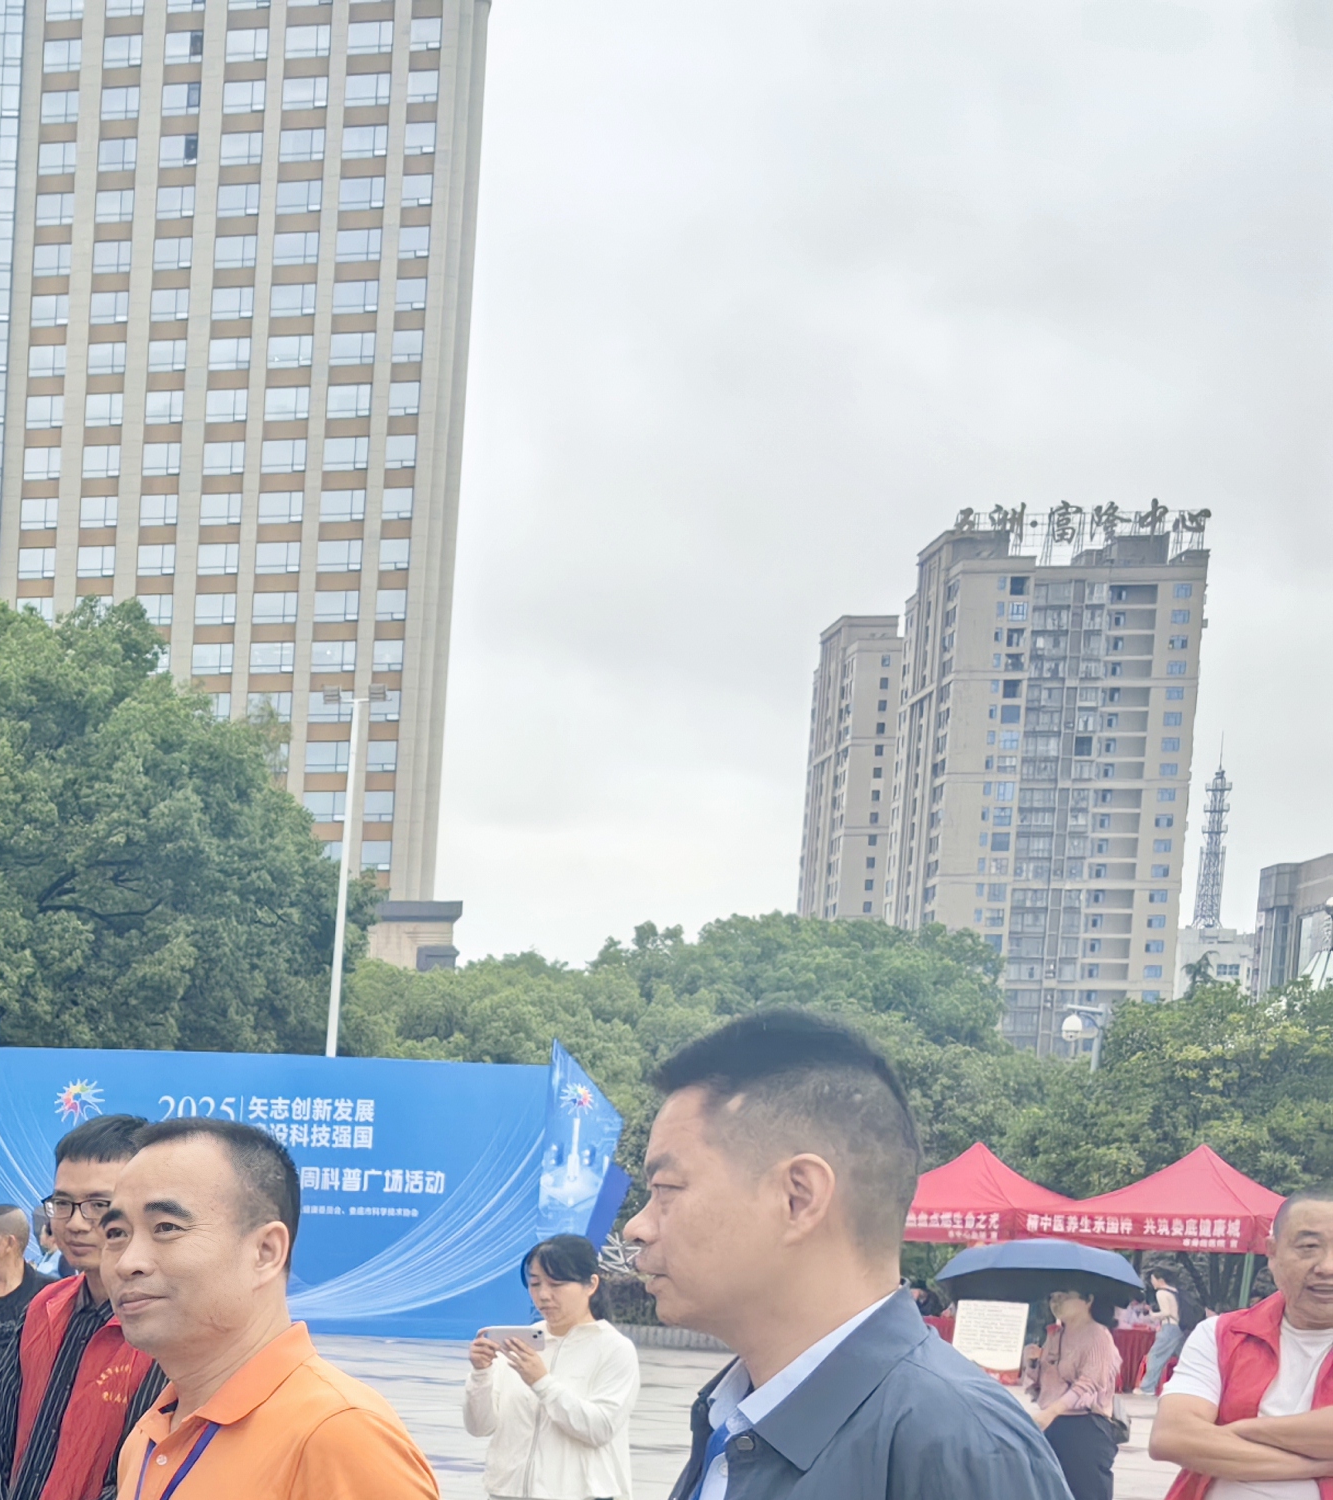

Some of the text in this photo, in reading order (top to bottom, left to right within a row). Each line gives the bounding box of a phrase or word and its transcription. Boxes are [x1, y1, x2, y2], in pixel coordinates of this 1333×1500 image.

[248, 1096, 375, 1122] 矢志创新发展
[255, 1123, 374, 1149] 设科技强国
[300, 1166, 445, 1194] 周科普广场活动
